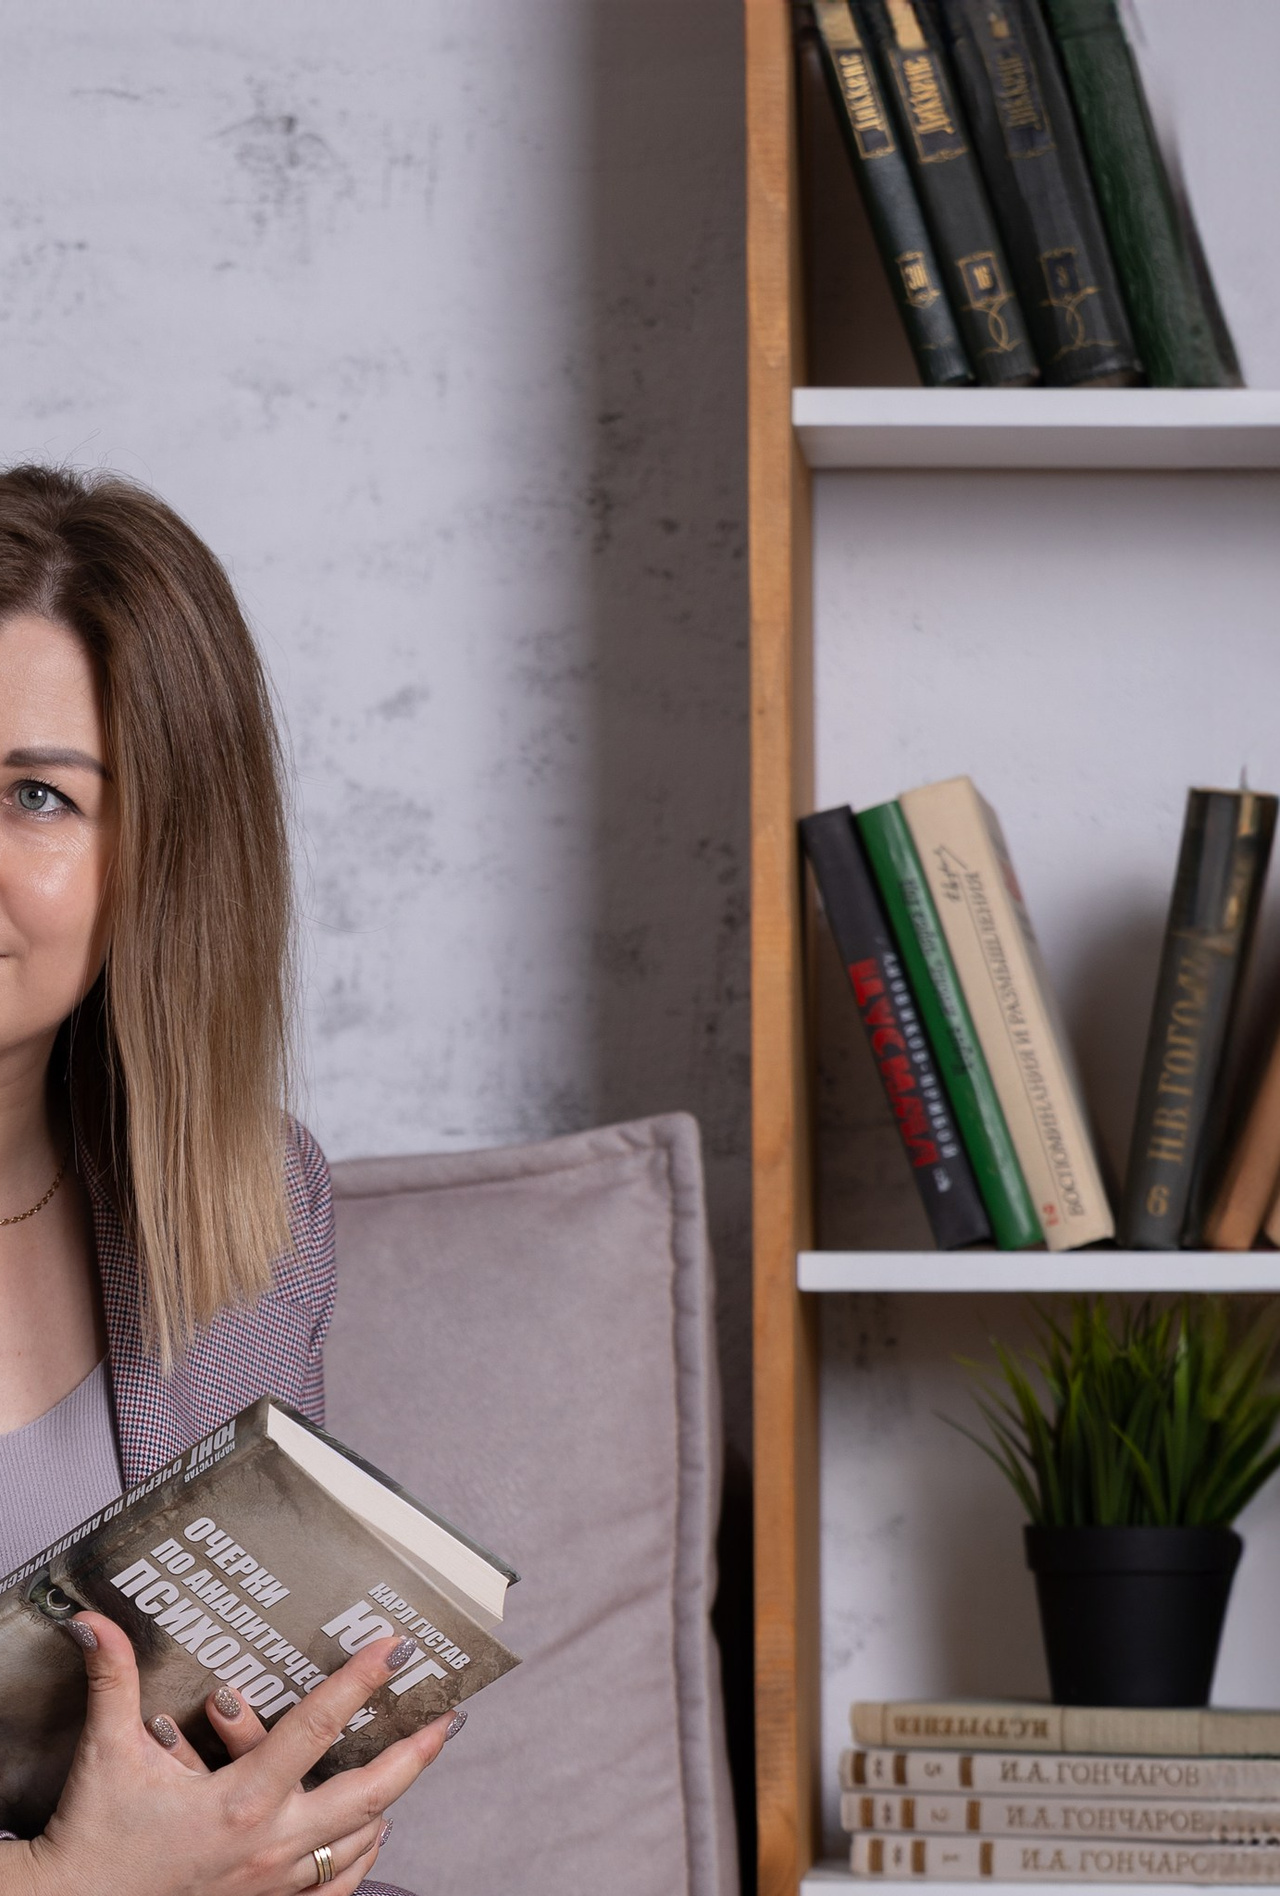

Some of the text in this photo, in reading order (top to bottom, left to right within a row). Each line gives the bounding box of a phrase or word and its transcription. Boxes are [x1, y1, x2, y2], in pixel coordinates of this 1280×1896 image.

[848, 957, 939, 1168] ЦУСИМА
[966, 870, 1084, 1217] ВОСПОМИНАНИЯ И РАЗМЫШЛЕНИЯ
[1147, 1185, 1168, 1217] 6
[184, 1441, 236, 1483] КАРЛ ГУСТАВ
[186, 1419, 236, 1471] ЮНГ
[104, 1499, 123, 1522] ПО
[127, 1459, 182, 1507] ОЧЕРКИ
[183, 1517, 291, 1609] ОЧЕРКИ
[110, 1558, 345, 1747] ПСИХОЛОГ
[150, 1538, 377, 1733] ПО АНАЛИТИЧЕСЙ
[368, 1582, 471, 1670] КАРЛ ГУСТАВ
[1056, 1763, 1200, 1788] ГОНЧАРОВ
